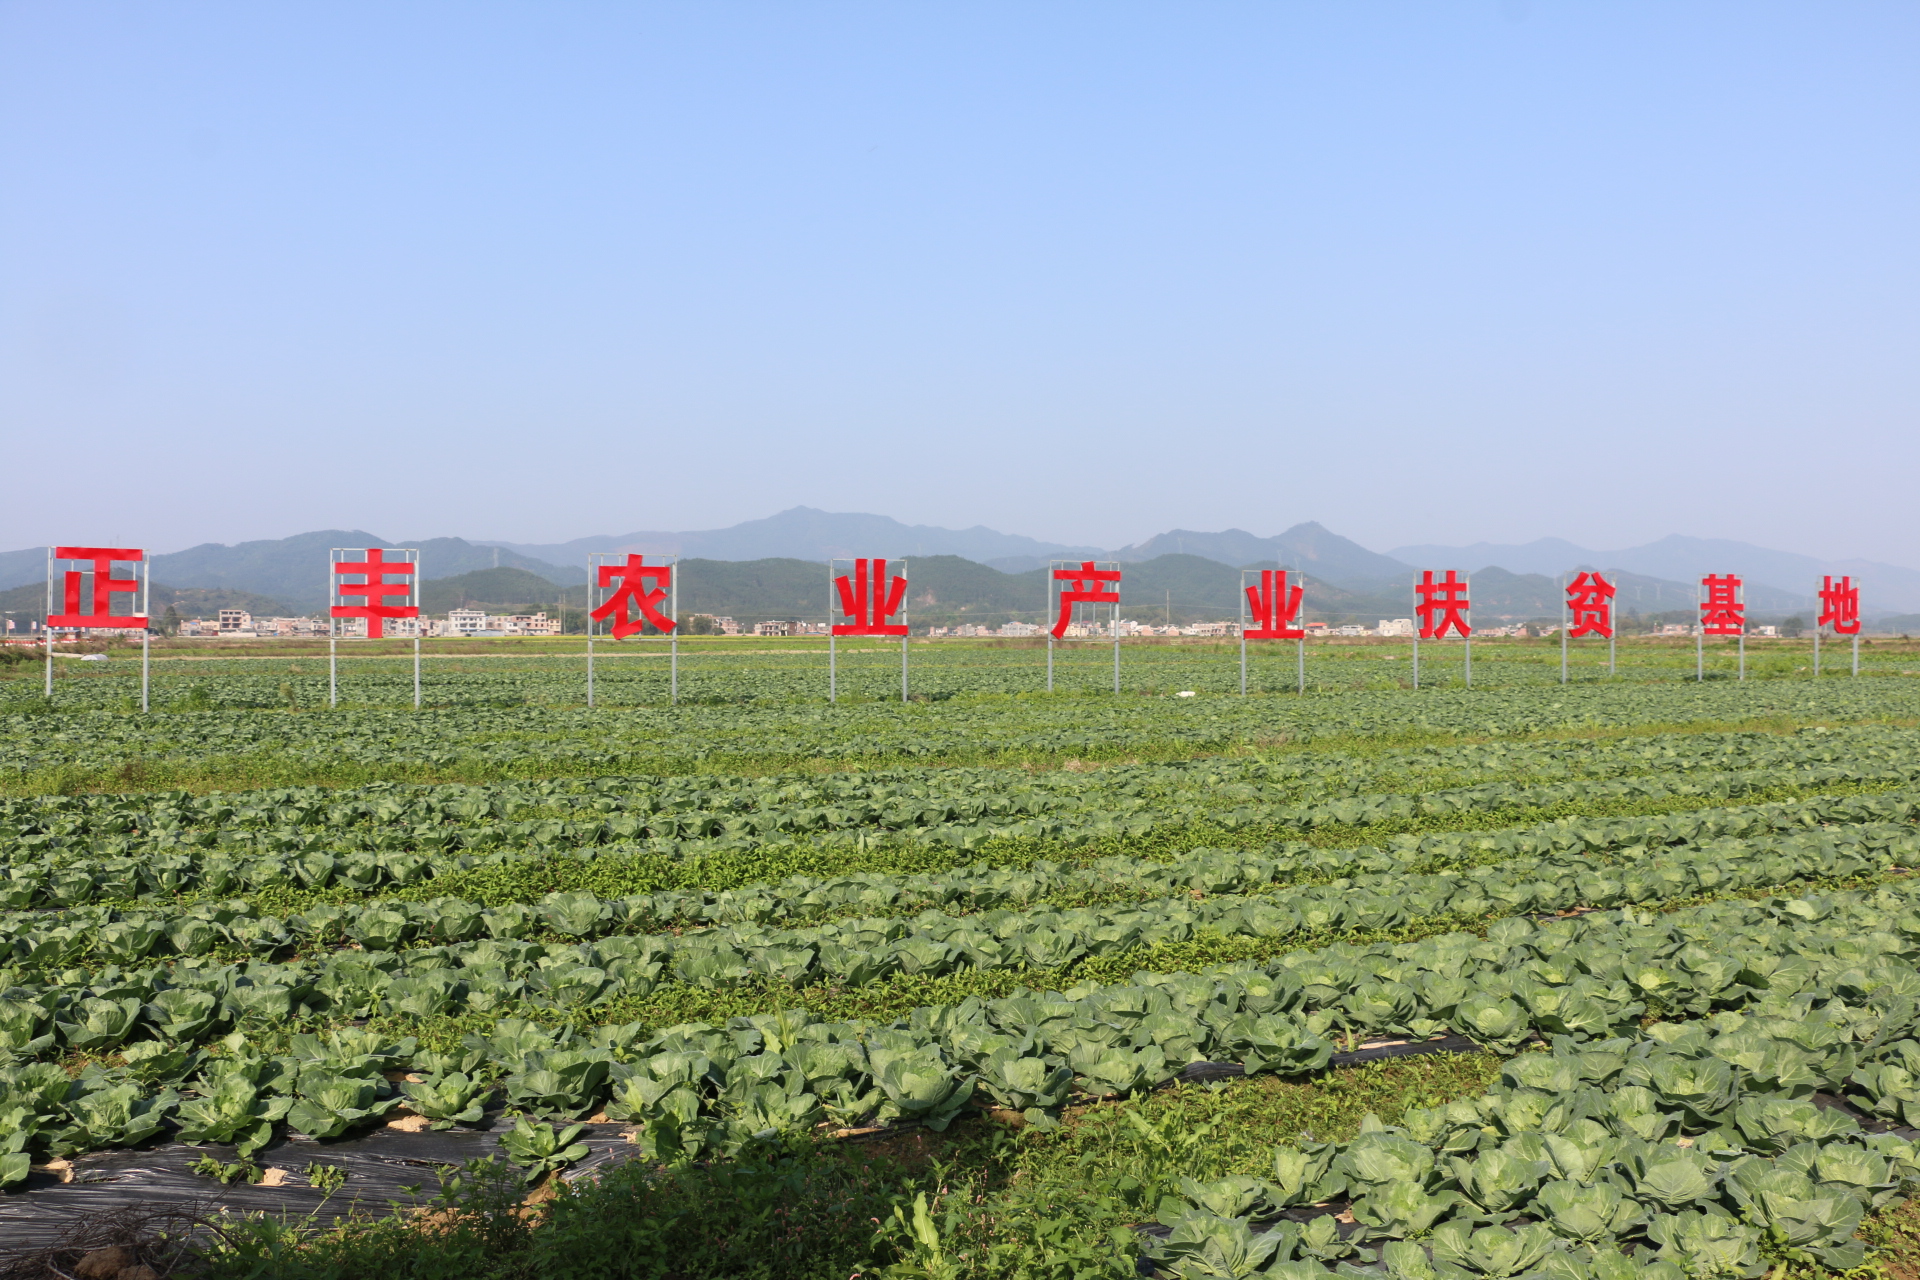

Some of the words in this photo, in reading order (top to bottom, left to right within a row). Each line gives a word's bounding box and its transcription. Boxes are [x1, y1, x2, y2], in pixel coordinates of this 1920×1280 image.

[47, 547, 1860, 640] 正丰农业产业扶贫基地
